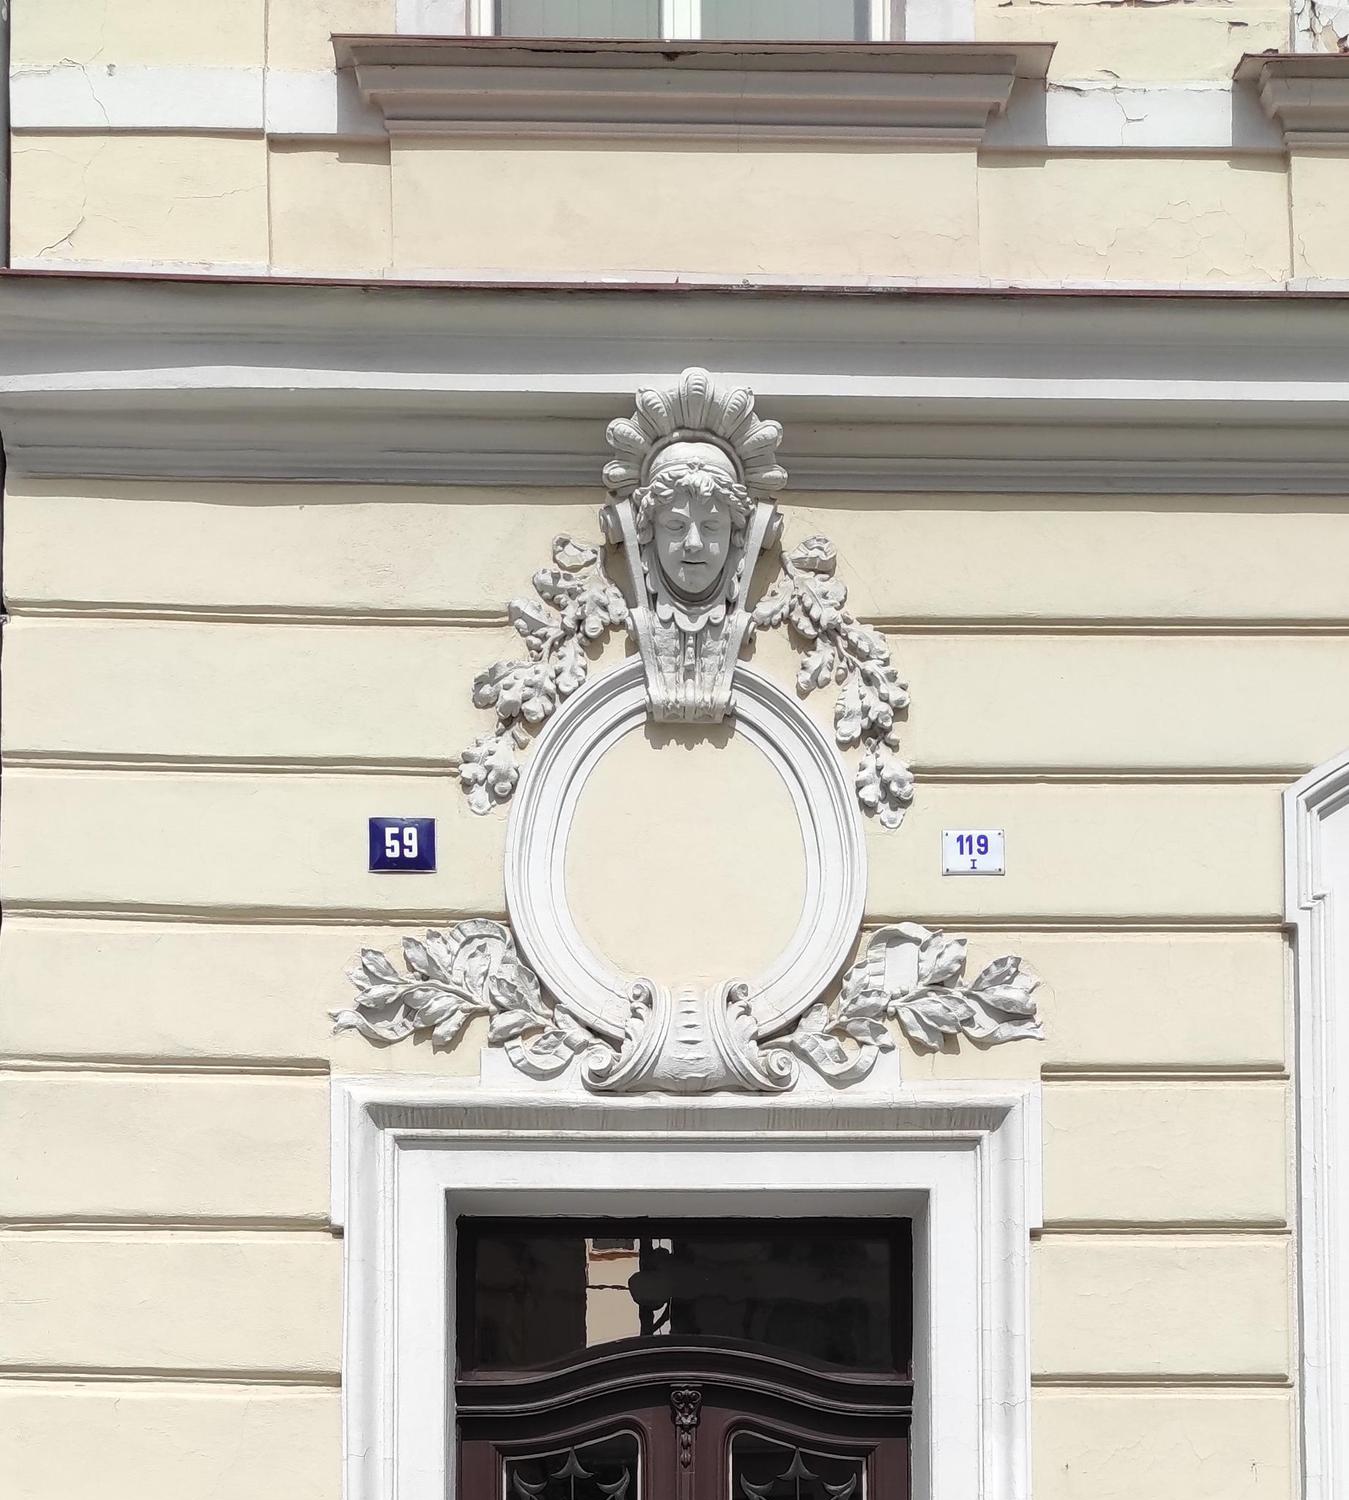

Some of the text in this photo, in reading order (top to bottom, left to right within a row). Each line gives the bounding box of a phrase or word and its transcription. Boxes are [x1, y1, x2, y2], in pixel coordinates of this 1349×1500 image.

[385, 827, 418, 858] 59
[956, 834, 989, 855] 119
[970, 858, 977, 869] I
